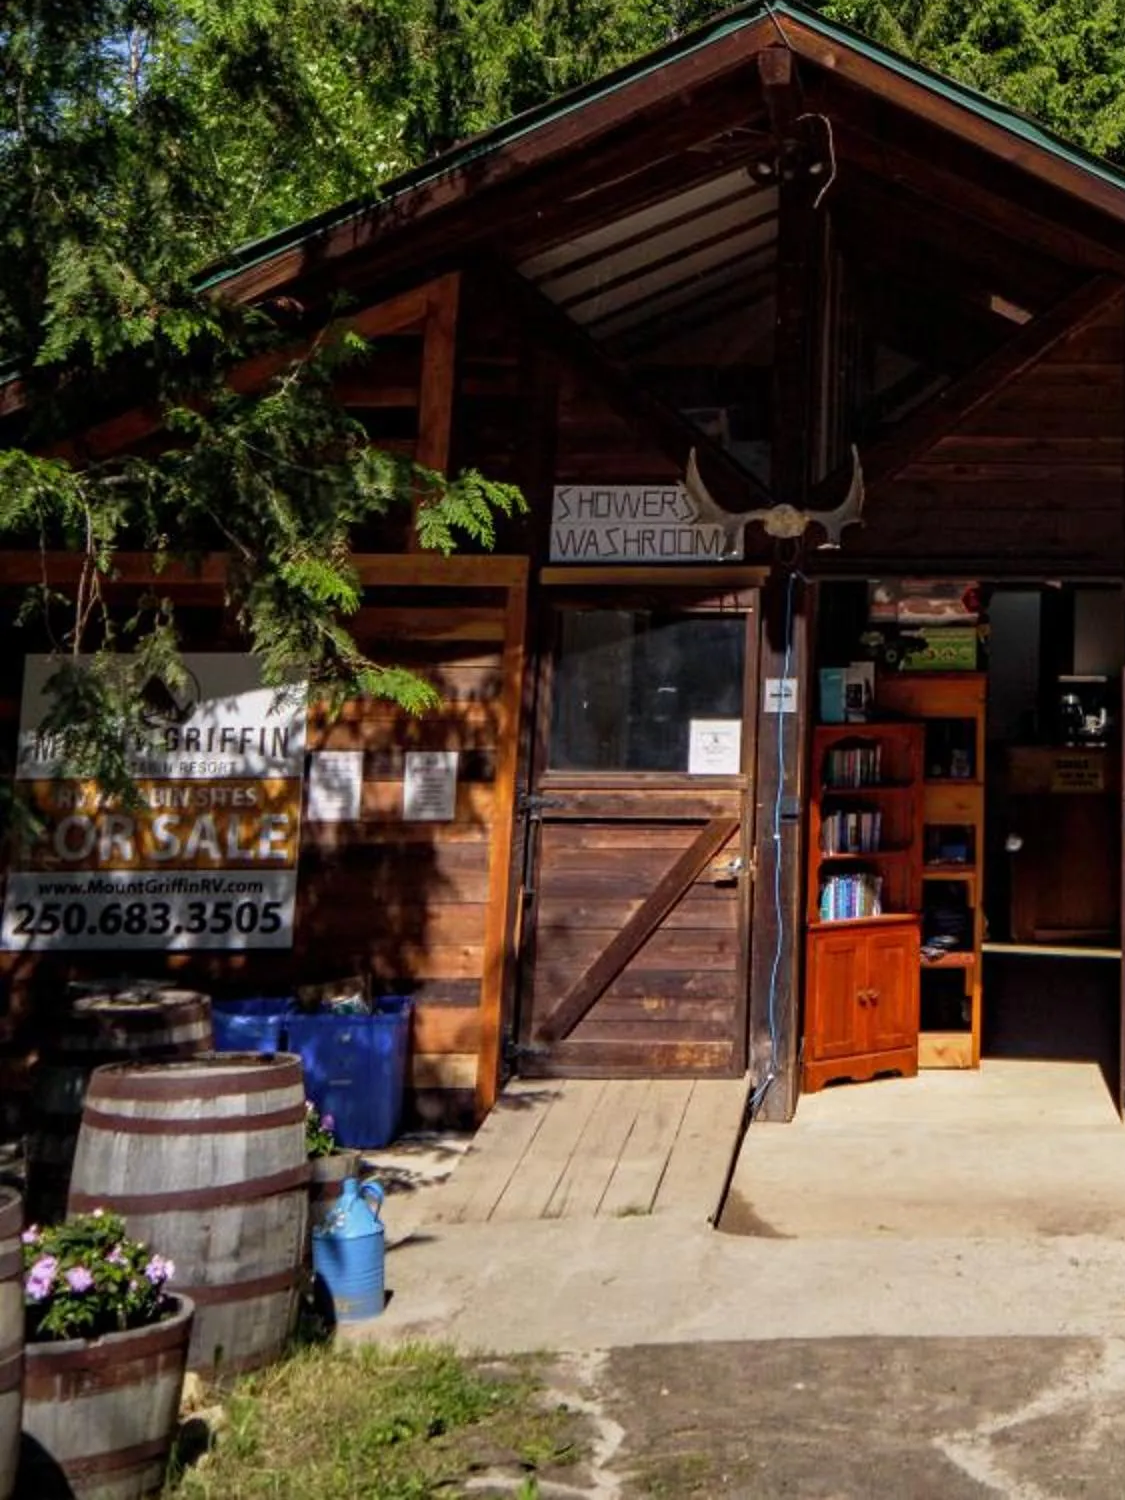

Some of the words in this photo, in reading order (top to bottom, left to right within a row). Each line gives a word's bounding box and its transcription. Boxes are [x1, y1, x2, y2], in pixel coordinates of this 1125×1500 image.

[557, 487, 695, 521] SHOWERS
[556, 526, 736, 557] WASHROOM
[163, 725, 290, 759] GRIFFIN
[195, 786, 258, 808] SITES
[26, 812, 136, 863] OR
[151, 811, 291, 863] SALE
[38, 876, 264, 896] www.MountGriffinRV.com
[14, 900, 283, 936] 250.683.3505
